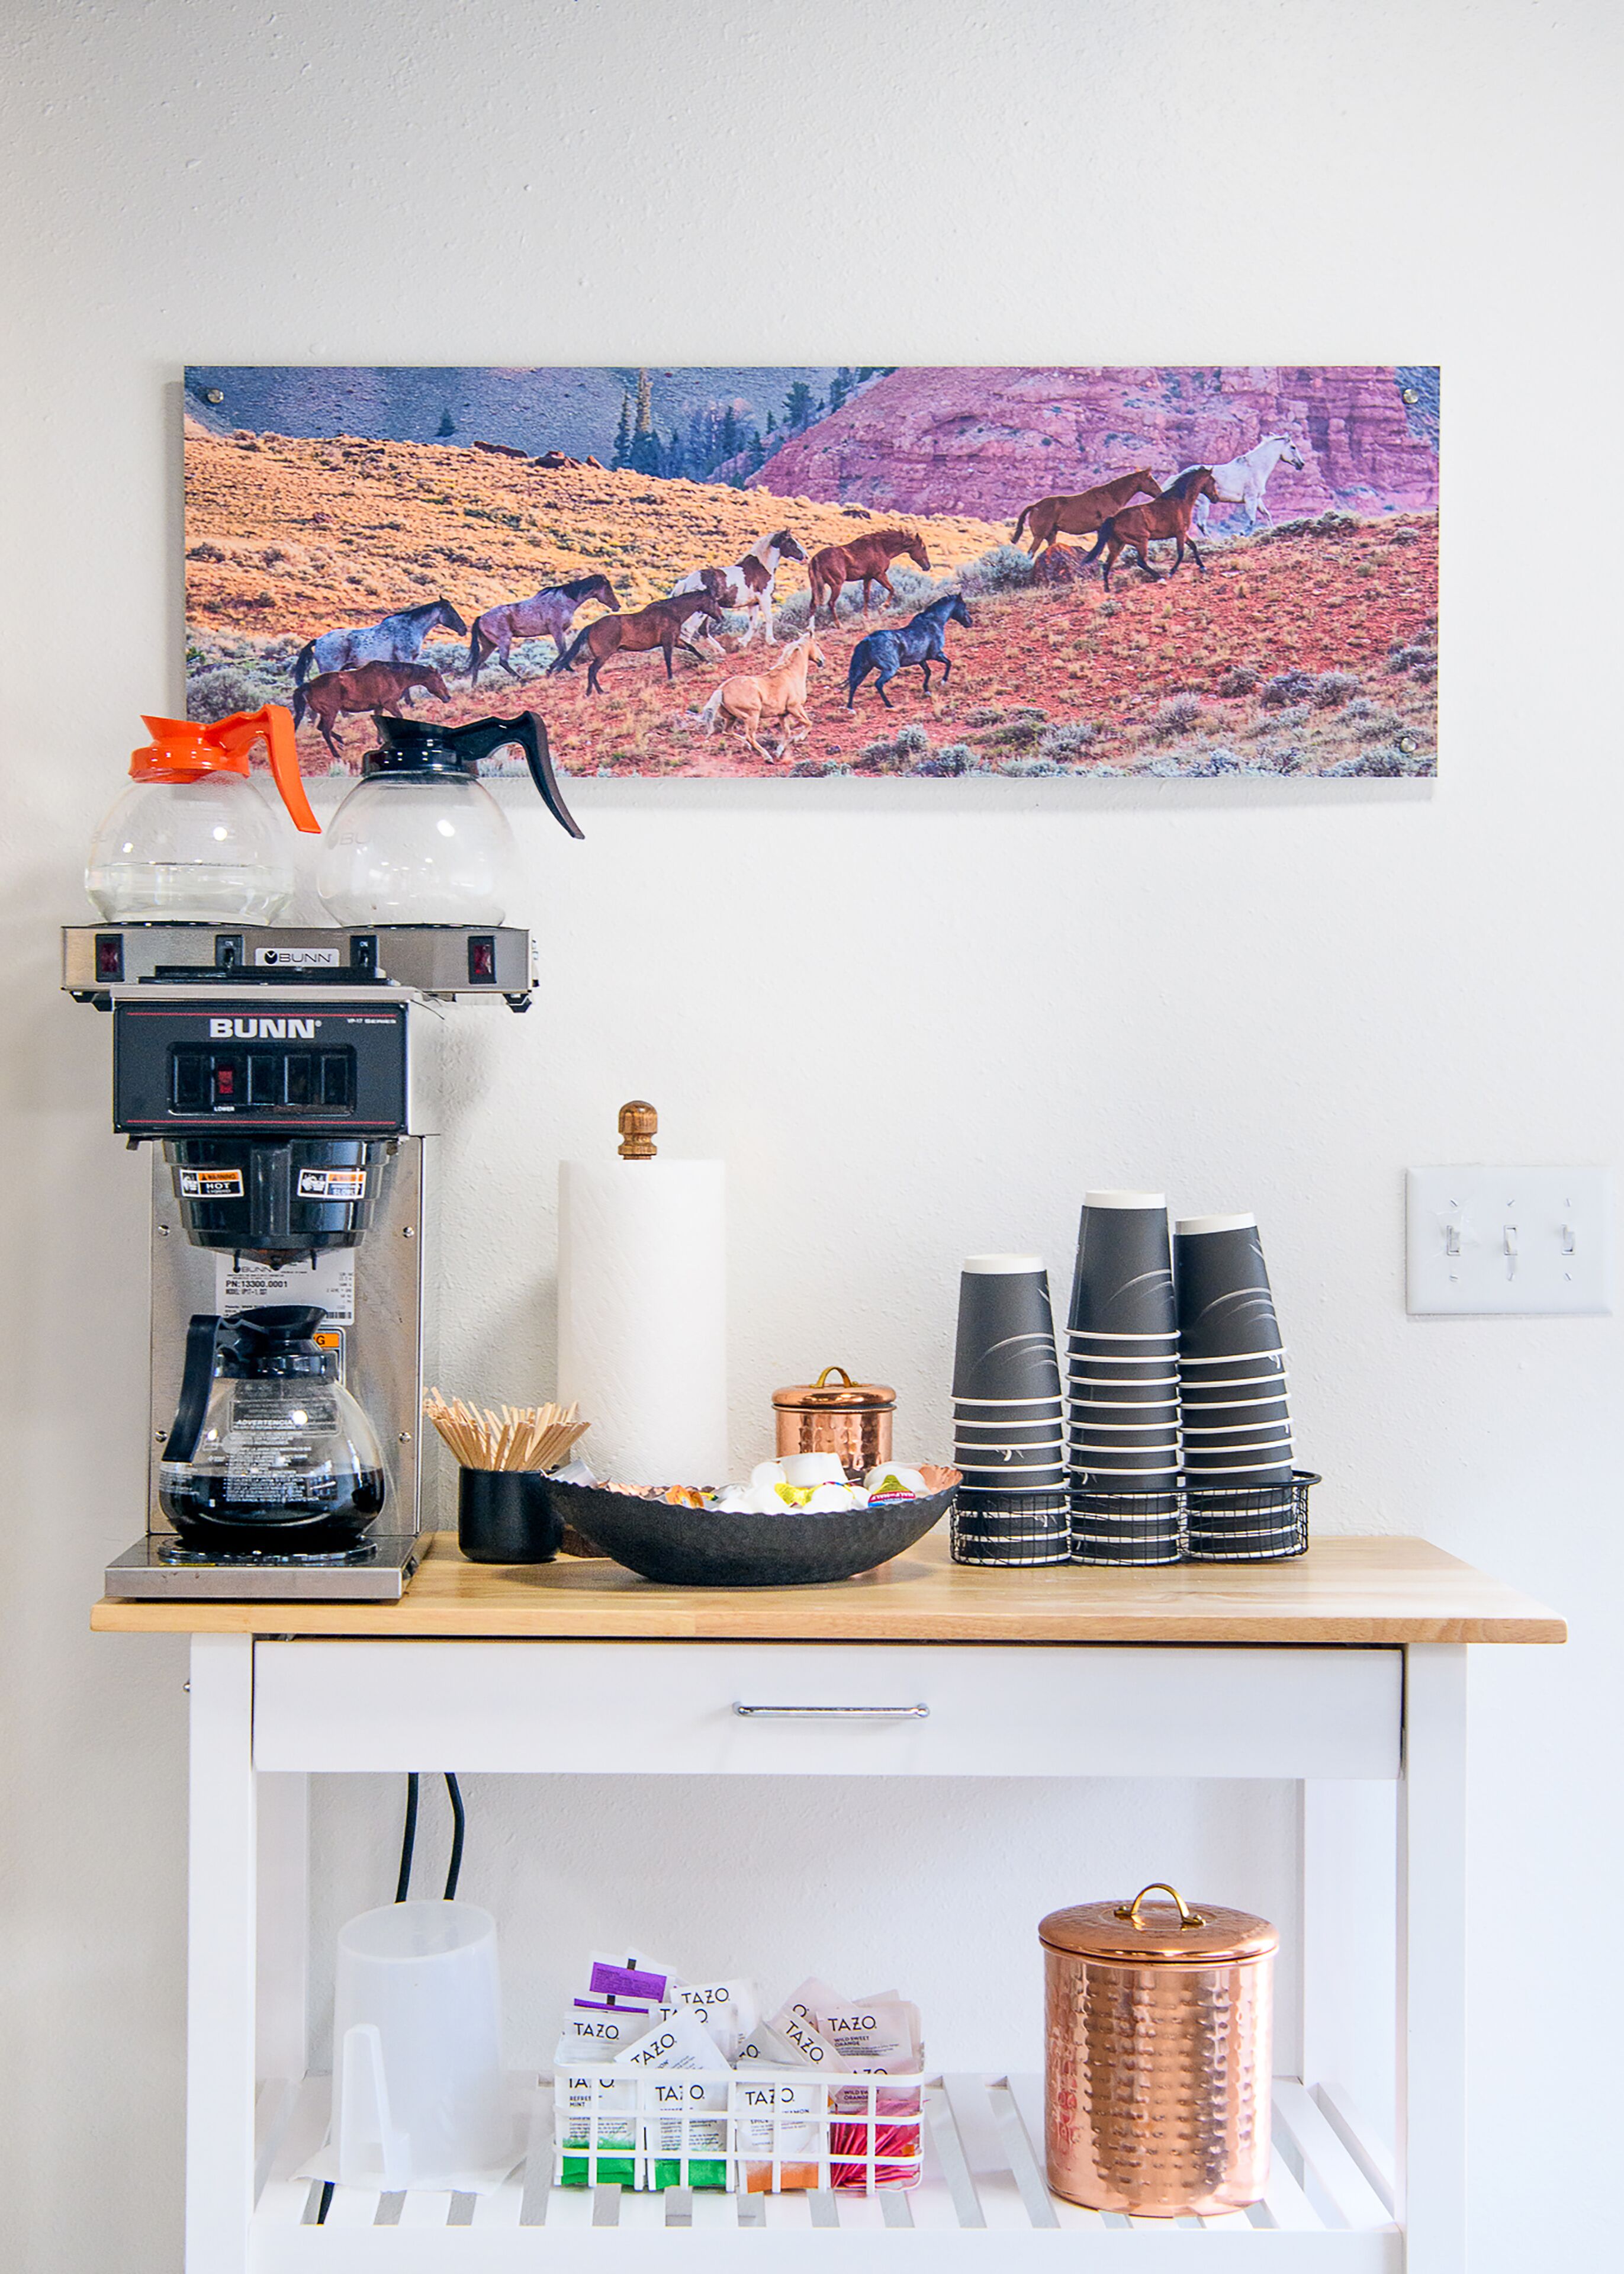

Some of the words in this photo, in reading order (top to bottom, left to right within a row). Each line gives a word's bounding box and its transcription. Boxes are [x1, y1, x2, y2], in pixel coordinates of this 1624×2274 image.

[279, 953, 330, 963] BUNN
[210, 1018, 315, 1039] BUNN
[681, 1987, 729, 2004] TAZO
[573, 2022, 619, 2039] TAZO
[827, 2015, 876, 2031] TAZO
[786, 2020, 824, 2061] TAZO
[631, 2033, 676, 2066] TAZO
